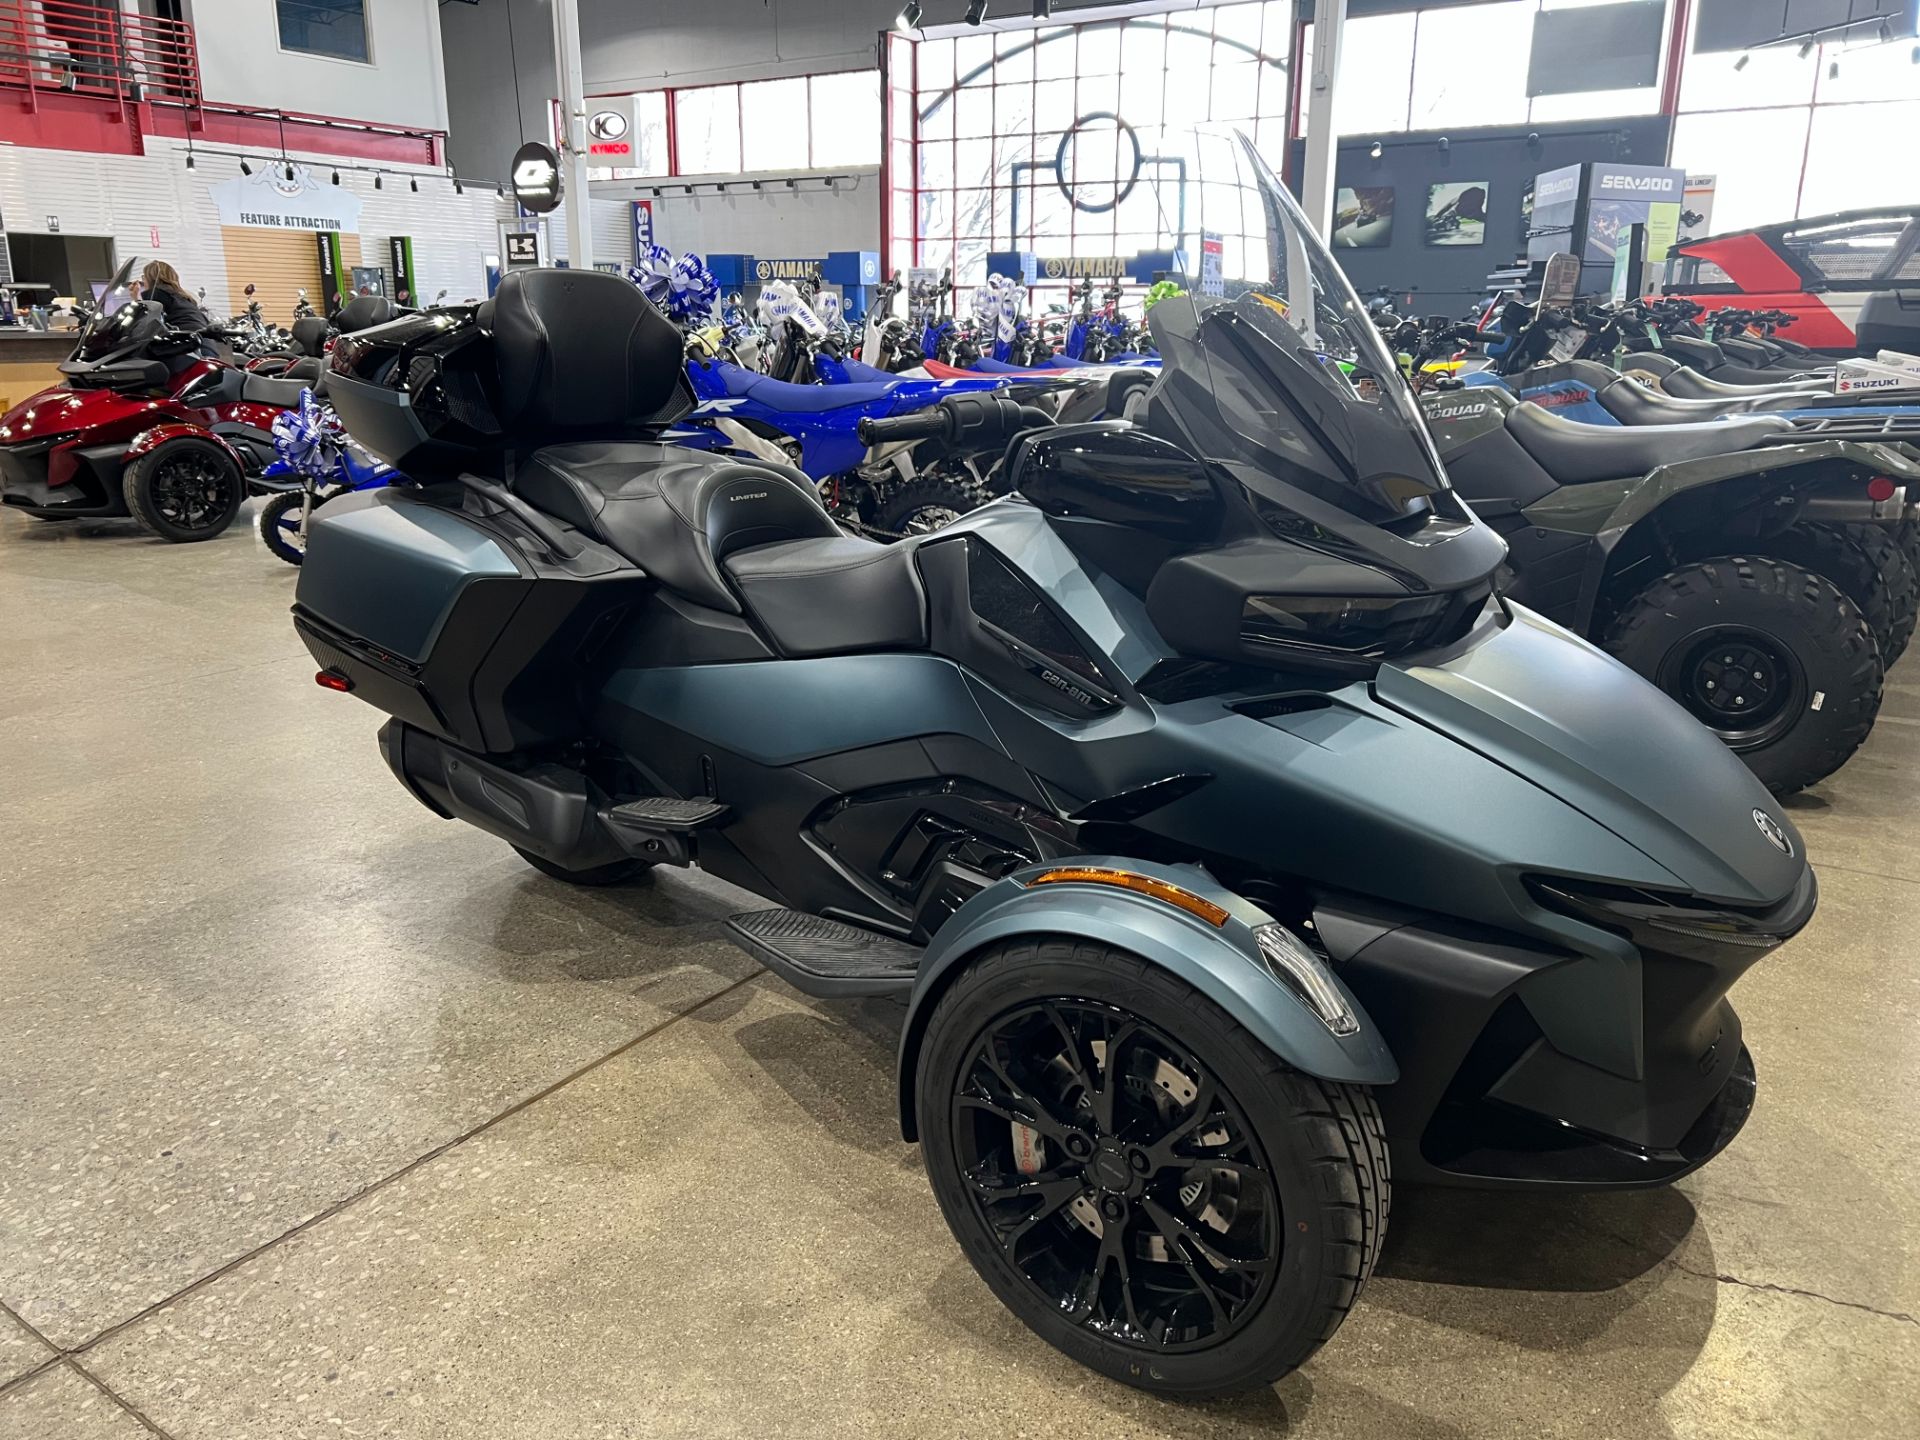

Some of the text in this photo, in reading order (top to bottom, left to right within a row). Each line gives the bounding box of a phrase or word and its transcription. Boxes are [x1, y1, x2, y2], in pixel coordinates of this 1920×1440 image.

[590, 143, 629, 154] KYMCO
[240, 213, 341, 230] FEATURE ATTRACTION
[321, 236, 332, 275] Kawasaki
[395, 240, 404, 278] Kawasaki
[771, 261, 819, 278] YAMAH
[1063, 258, 1126, 278] YAMAHA
[1853, 379, 1899, 389] SUZUKI
[730, 492, 768, 502] LIMITED
[1041, 669, 1092, 705] can-am
